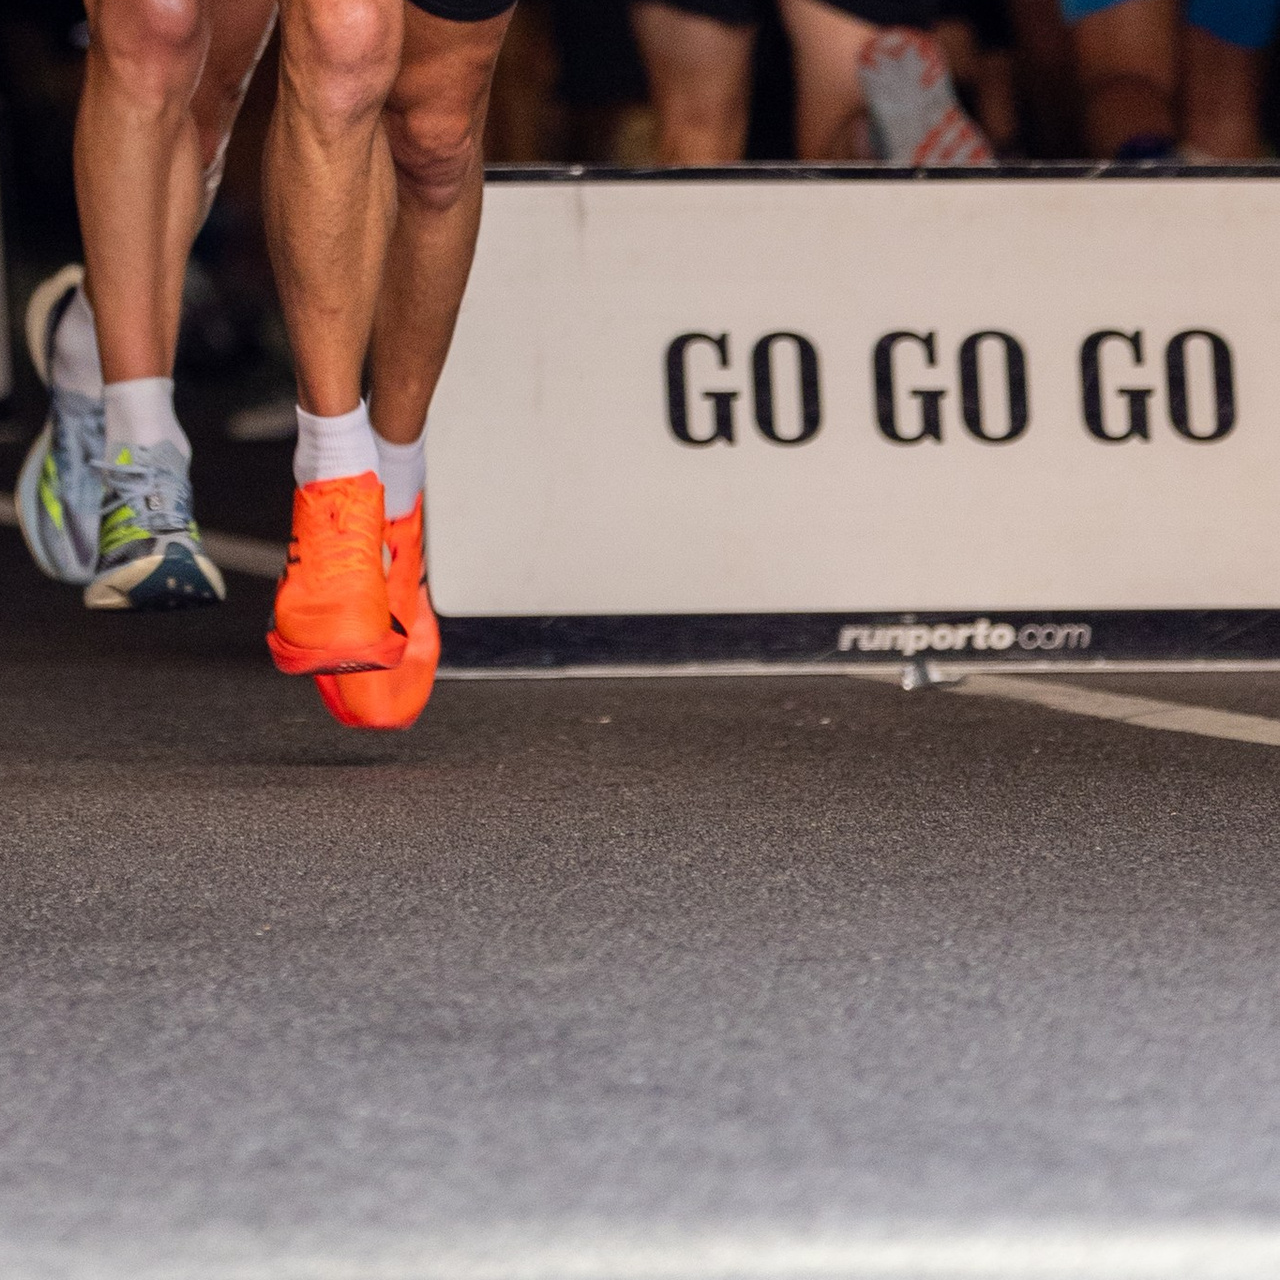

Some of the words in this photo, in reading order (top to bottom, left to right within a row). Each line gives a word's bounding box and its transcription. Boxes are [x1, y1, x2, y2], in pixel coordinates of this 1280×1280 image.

[663, 331, 824, 448] GO
[871, 330, 1031, 446] GO
[1078, 328, 1238, 445] GO
